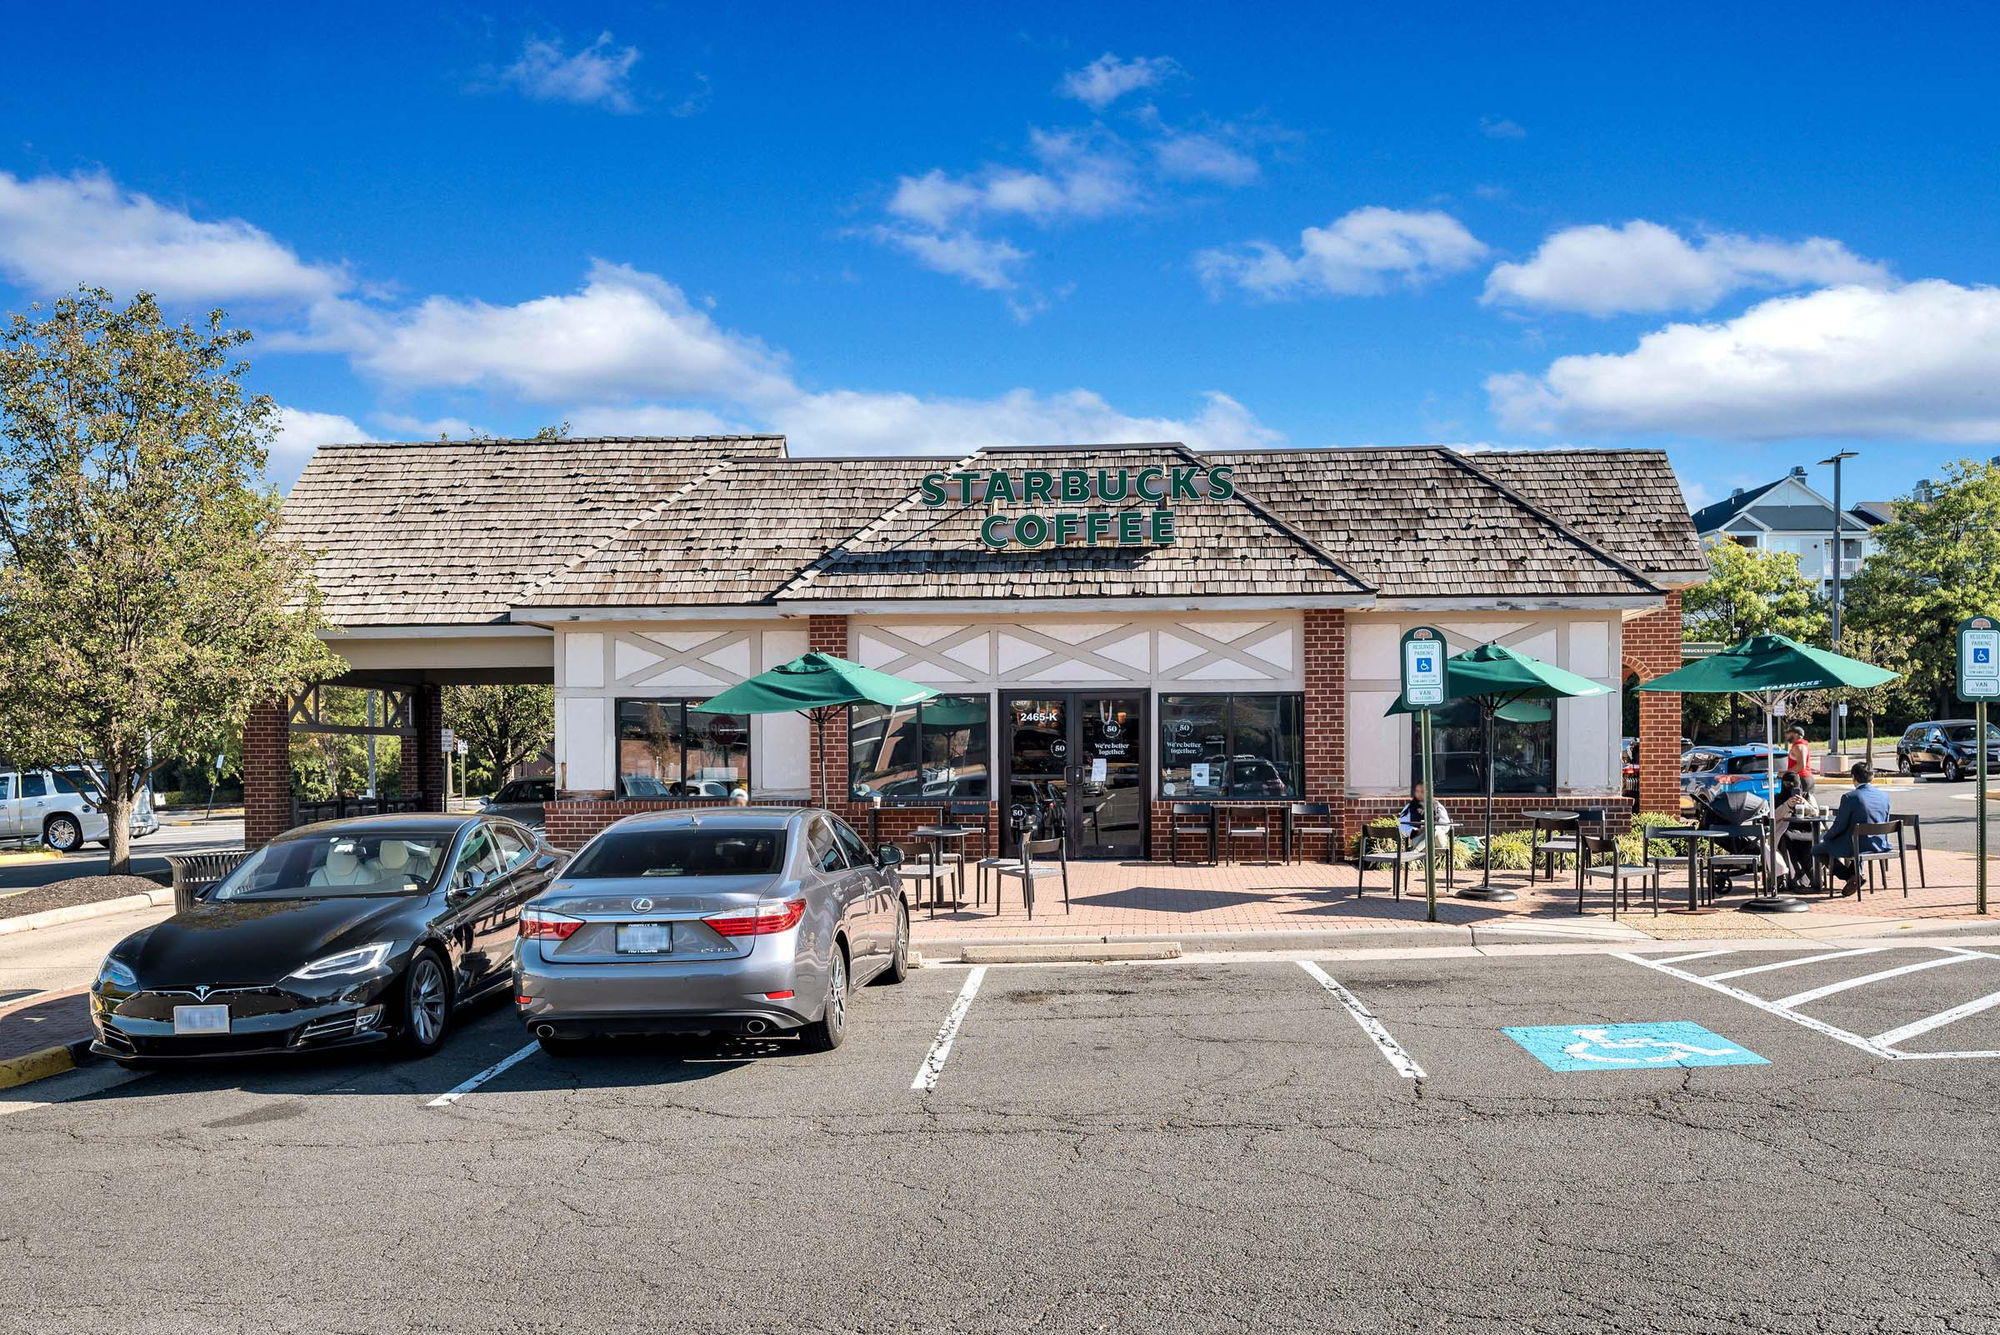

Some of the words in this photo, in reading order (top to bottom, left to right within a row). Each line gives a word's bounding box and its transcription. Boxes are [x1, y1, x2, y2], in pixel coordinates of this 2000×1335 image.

[921, 466, 1234, 508] STARBUCKS
[980, 510, 1177, 548] COFFEE
[1020, 712, 1058, 722] 2465-K
